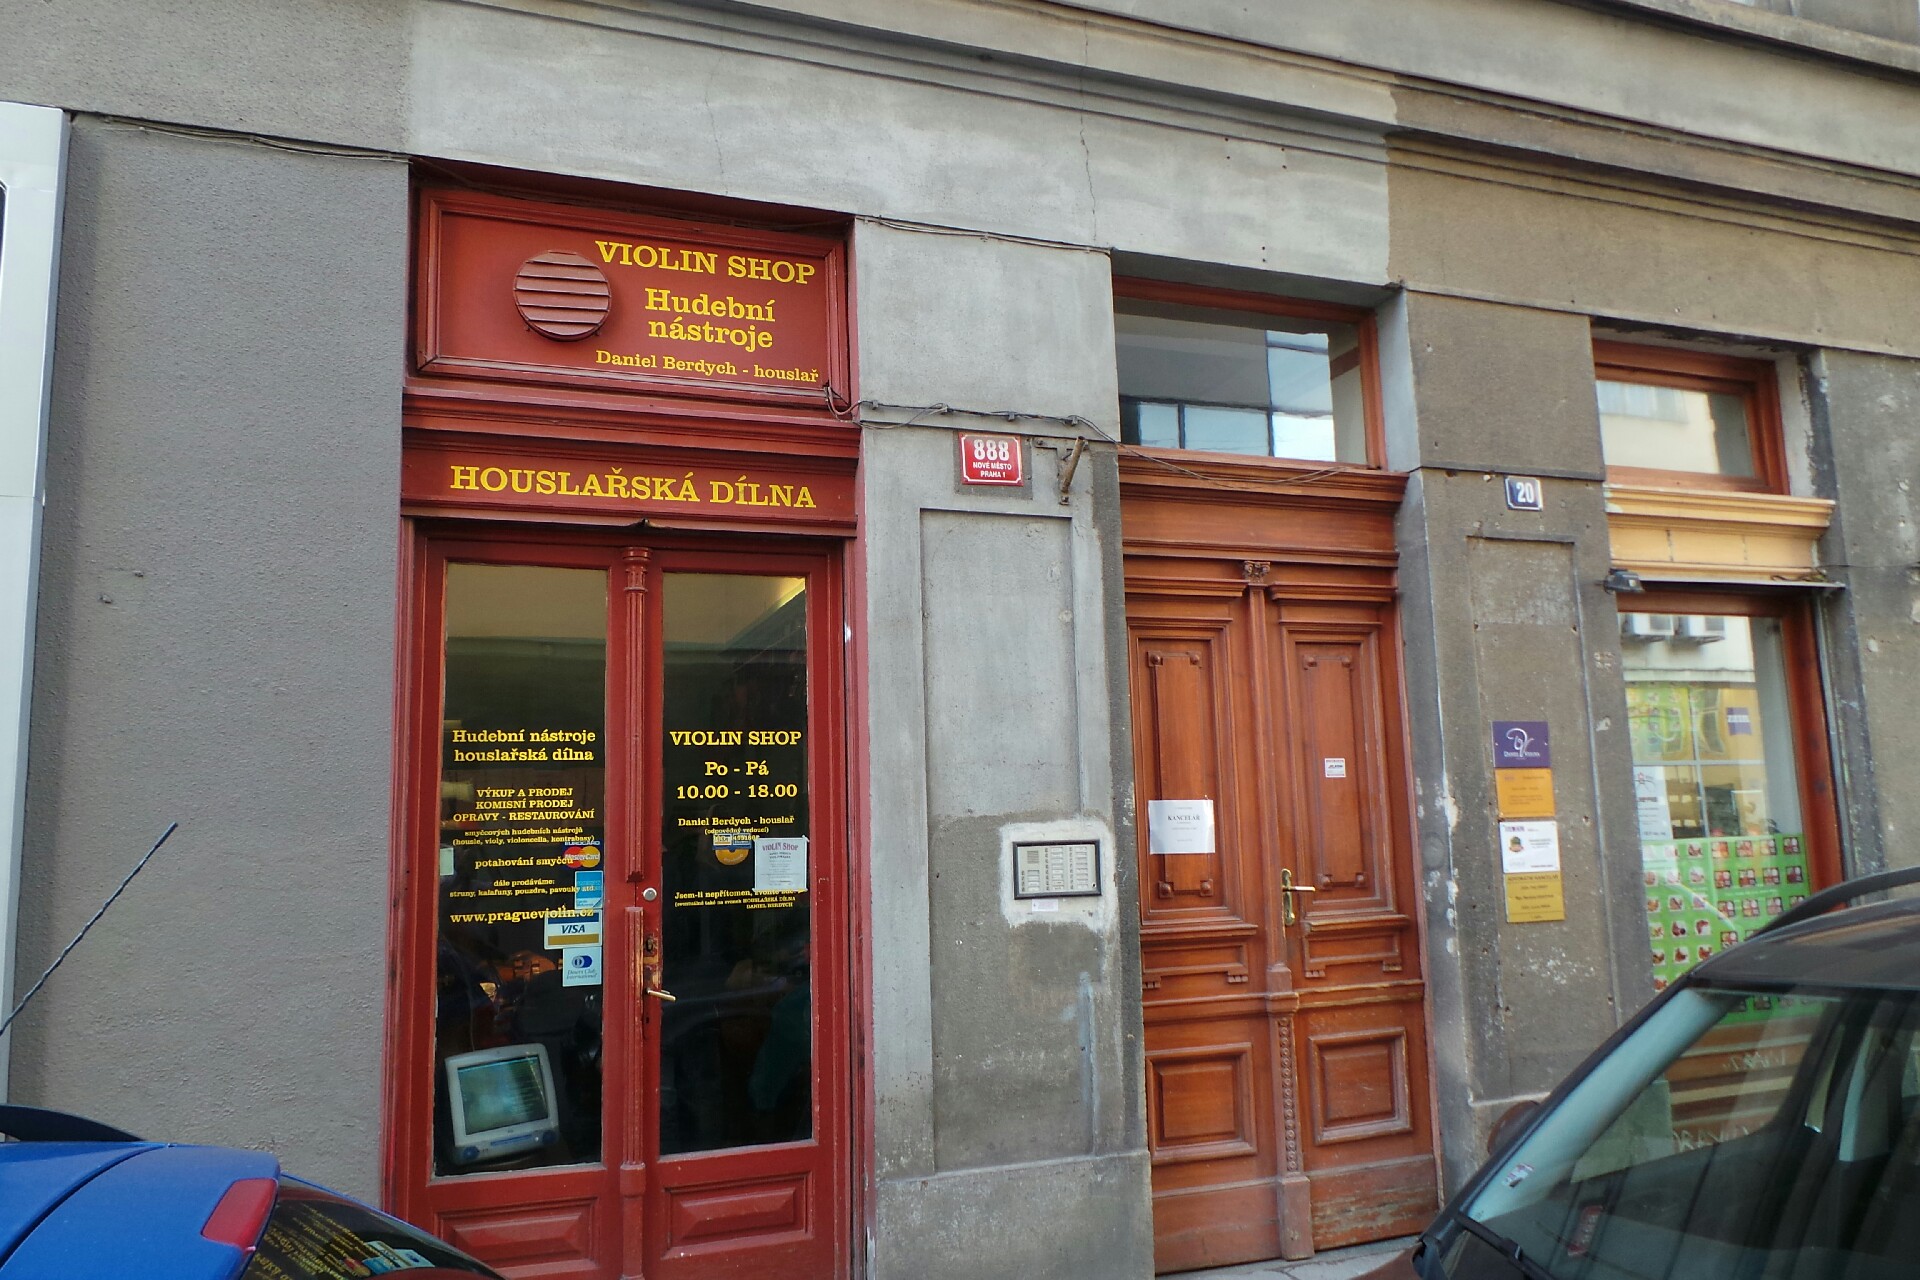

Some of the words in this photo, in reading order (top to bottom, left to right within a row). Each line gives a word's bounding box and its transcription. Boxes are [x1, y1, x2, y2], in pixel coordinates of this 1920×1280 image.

[595, 240, 717, 275] VIOLIN
[727, 255, 815, 285] SHOP
[644, 288, 775, 322] Hudební
[649, 320, 773, 352] nástroje
[596, 350, 657, 369] Daniel
[662, 356, 737, 377] Berdych
[754, 364, 819, 383] houslař
[973, 439, 1010, 461] 888
[991, 462, 1012, 470] MĚSTO
[451, 465, 700, 503] HOUSLAŘSKÁ
[710, 476, 816, 508] DÍLNA
[1516, 482, 1534, 503] 20
[452, 729, 525, 743] Hudební
[530, 728, 596, 744] nástroje
[670, 731, 743, 746] VIOLIN
[748, 731, 801, 745] SHOP
[454, 748, 547, 762] houslařská
[552, 748, 594, 761] dílna
[704, 761, 729, 776] Po
[745, 760, 769, 776] Pá
[477, 787, 515, 798] VÝKUP
[517, 789, 526, 797] A
[528, 787, 573, 797] PRODEJ
[677, 785, 729, 799] 10.00
[748, 784, 798, 798] 18.00
[475, 798, 527, 809] KOMISNÍ
[529, 799, 573, 808] PRODEJ
[453, 812, 500, 822] OPRAVY
[509, 809, 595, 821] RESTAUROVÁNÍ
[678, 818, 709, 826] Daniel
[712, 817, 751, 826] Berdych
[760, 816, 795, 824] houslař
[475, 857, 534, 869] potahování
[512, 878, 555, 888] prodáváme:
[450, 904, 594, 924] www.pragueviolin.cz
[561, 925, 585, 934] VISA
